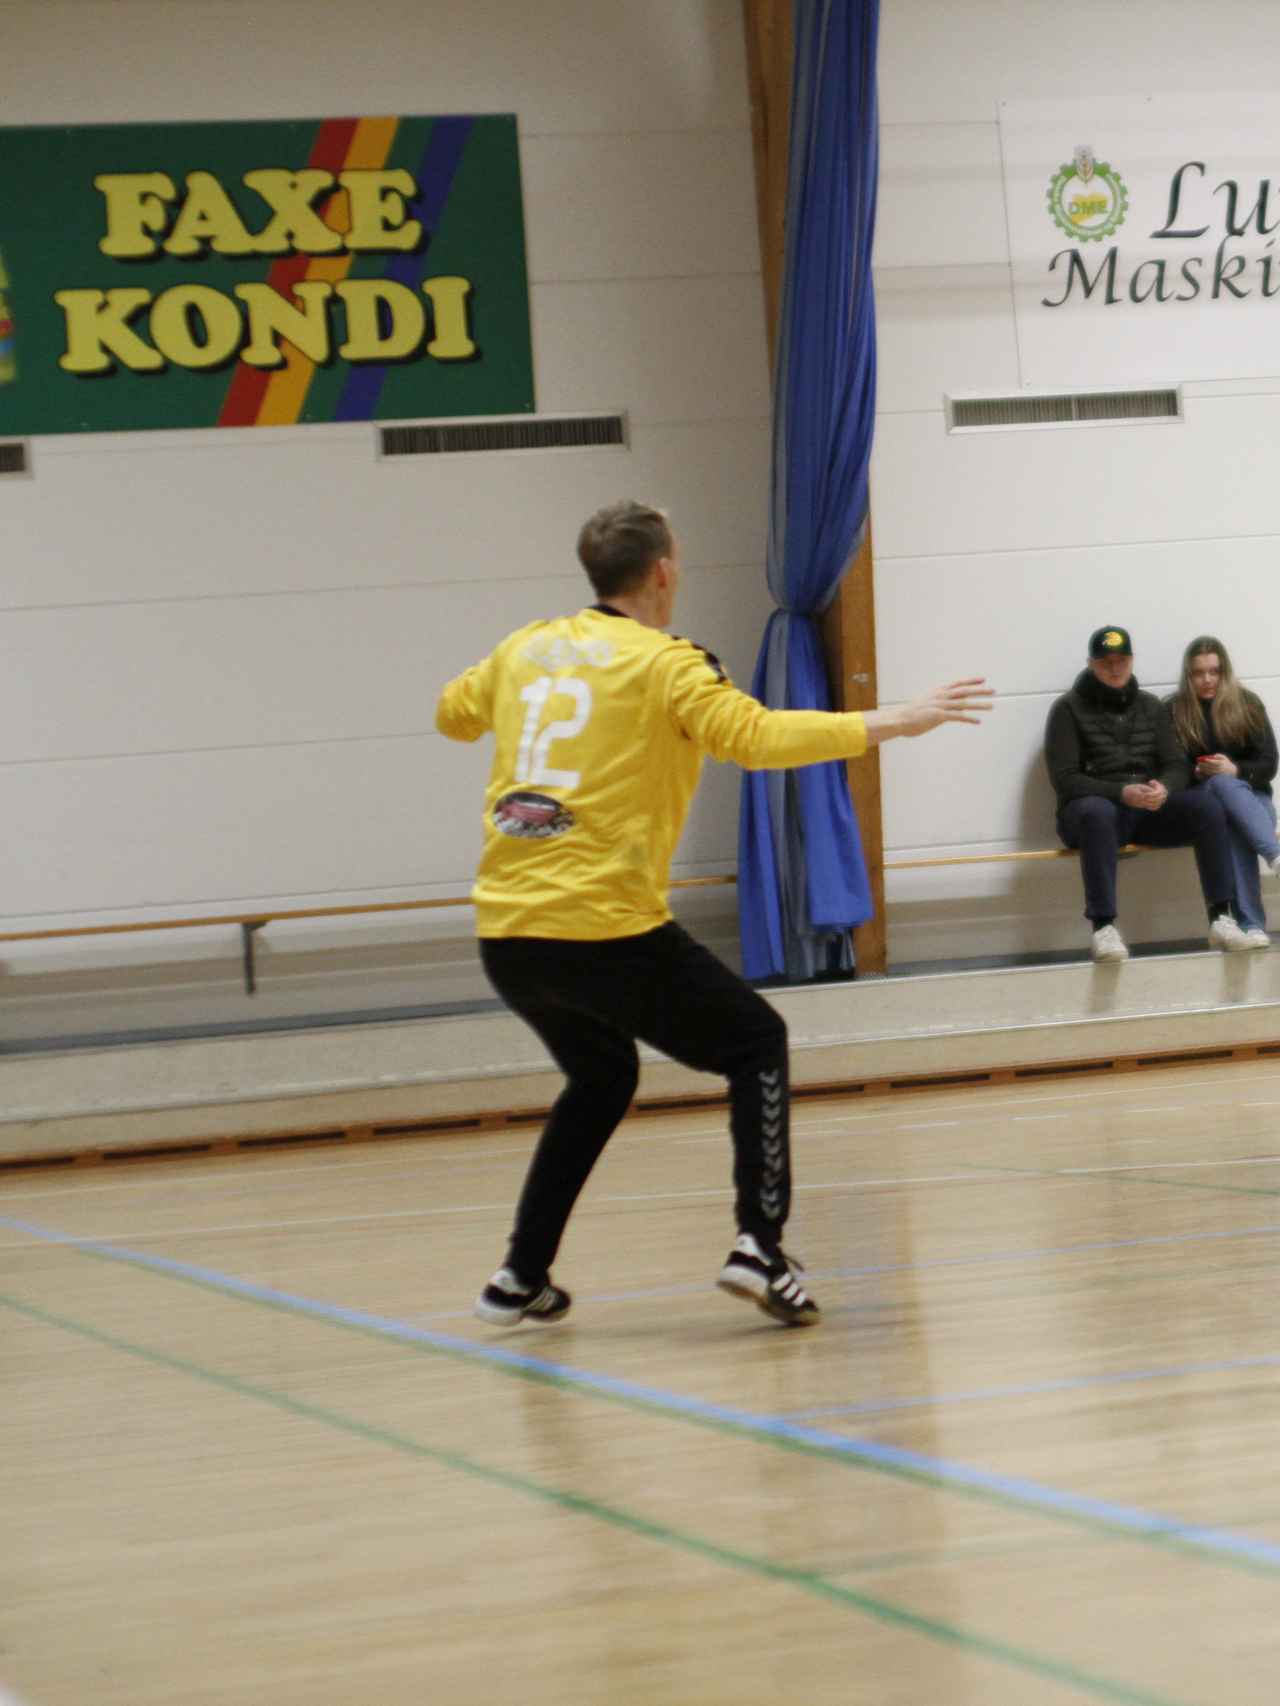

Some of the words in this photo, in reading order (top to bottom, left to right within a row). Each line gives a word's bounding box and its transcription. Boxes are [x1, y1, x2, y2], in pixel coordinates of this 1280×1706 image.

[94, 168, 424, 259] FAXE
[54, 276, 478, 374] KONDI
[514, 676, 592, 789] 12
